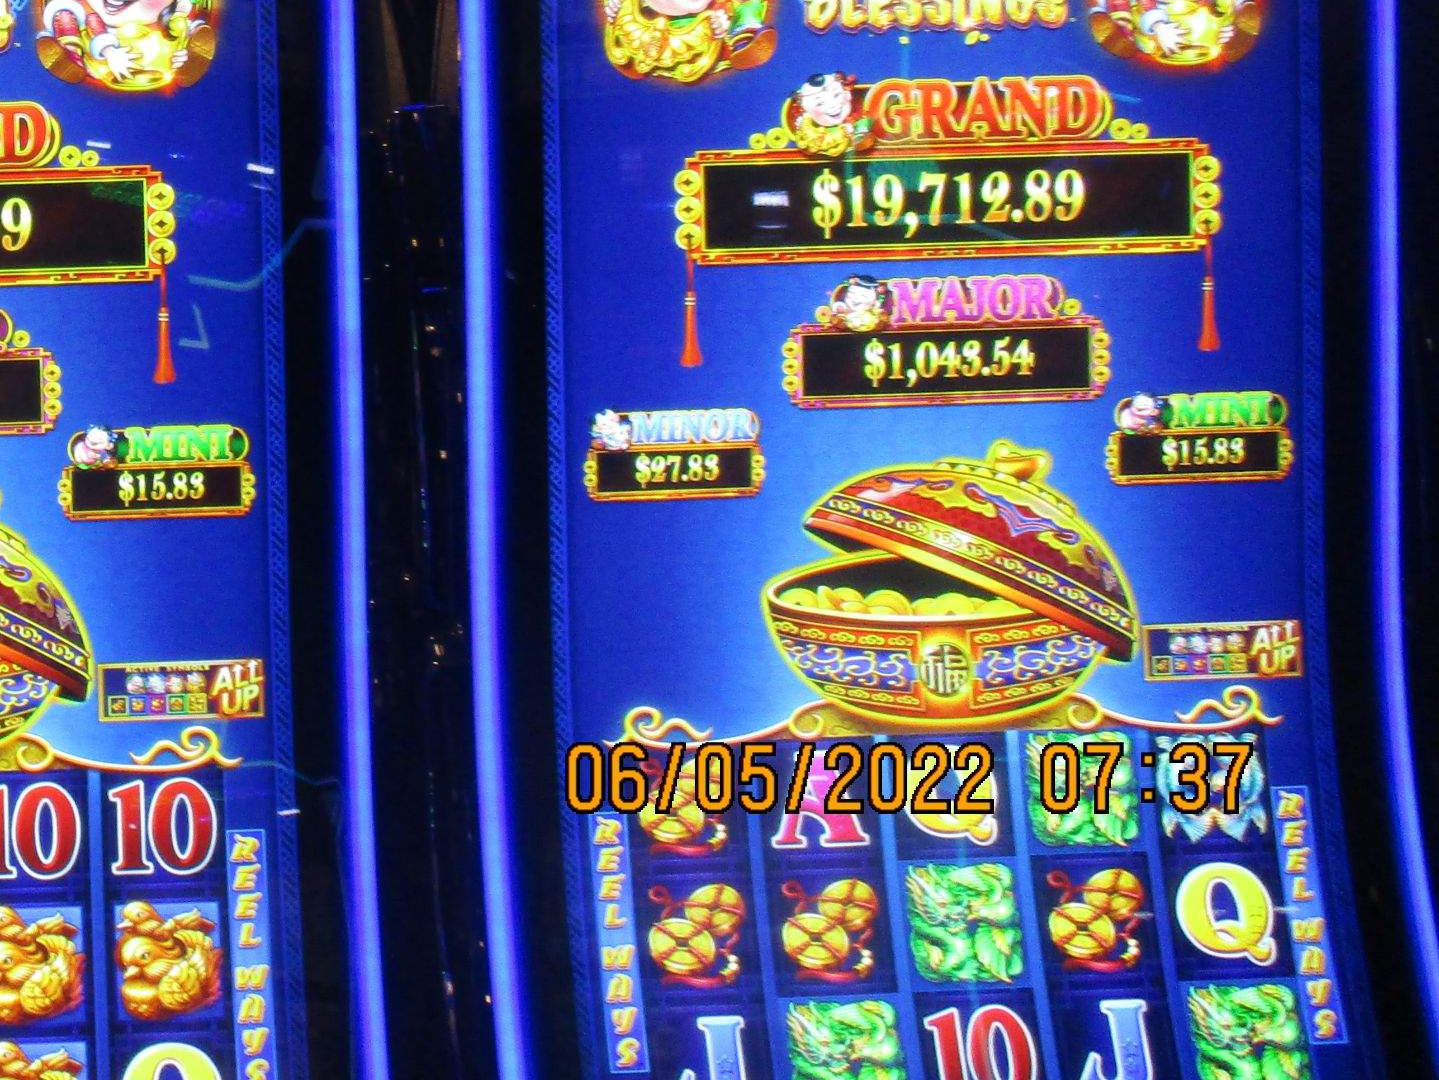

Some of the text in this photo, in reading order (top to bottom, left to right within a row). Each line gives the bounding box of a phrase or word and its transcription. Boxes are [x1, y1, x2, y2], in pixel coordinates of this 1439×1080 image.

[866, 75, 1105, 141] GRAND
[813, 169, 1085, 239] $19,712.89
[890, 275, 1059, 323] MAJOR
[865, 338, 1035, 387] $1,043.54
[628, 408, 756, 444] MINOR
[1169, 391, 1273, 428] MINI
[125, 425, 233, 463] MINI
[118, 471, 204, 506] $15.83
[636, 453, 719, 488] $27.83
[1248, 621, 1299, 656] ALL
[1260, 645, 1297, 674] UP
[210, 660, 263, 697] ALL
[221, 684, 260, 714] UP
[109, 777, 217, 875] 10
[232, 833, 262, 949] REEL
[1176, 863, 1278, 967] Q
[602, 944, 639, 1069] WAYS
[924, 1004, 1038, 1080] 10
[1079, 999, 1152, 1080] J
